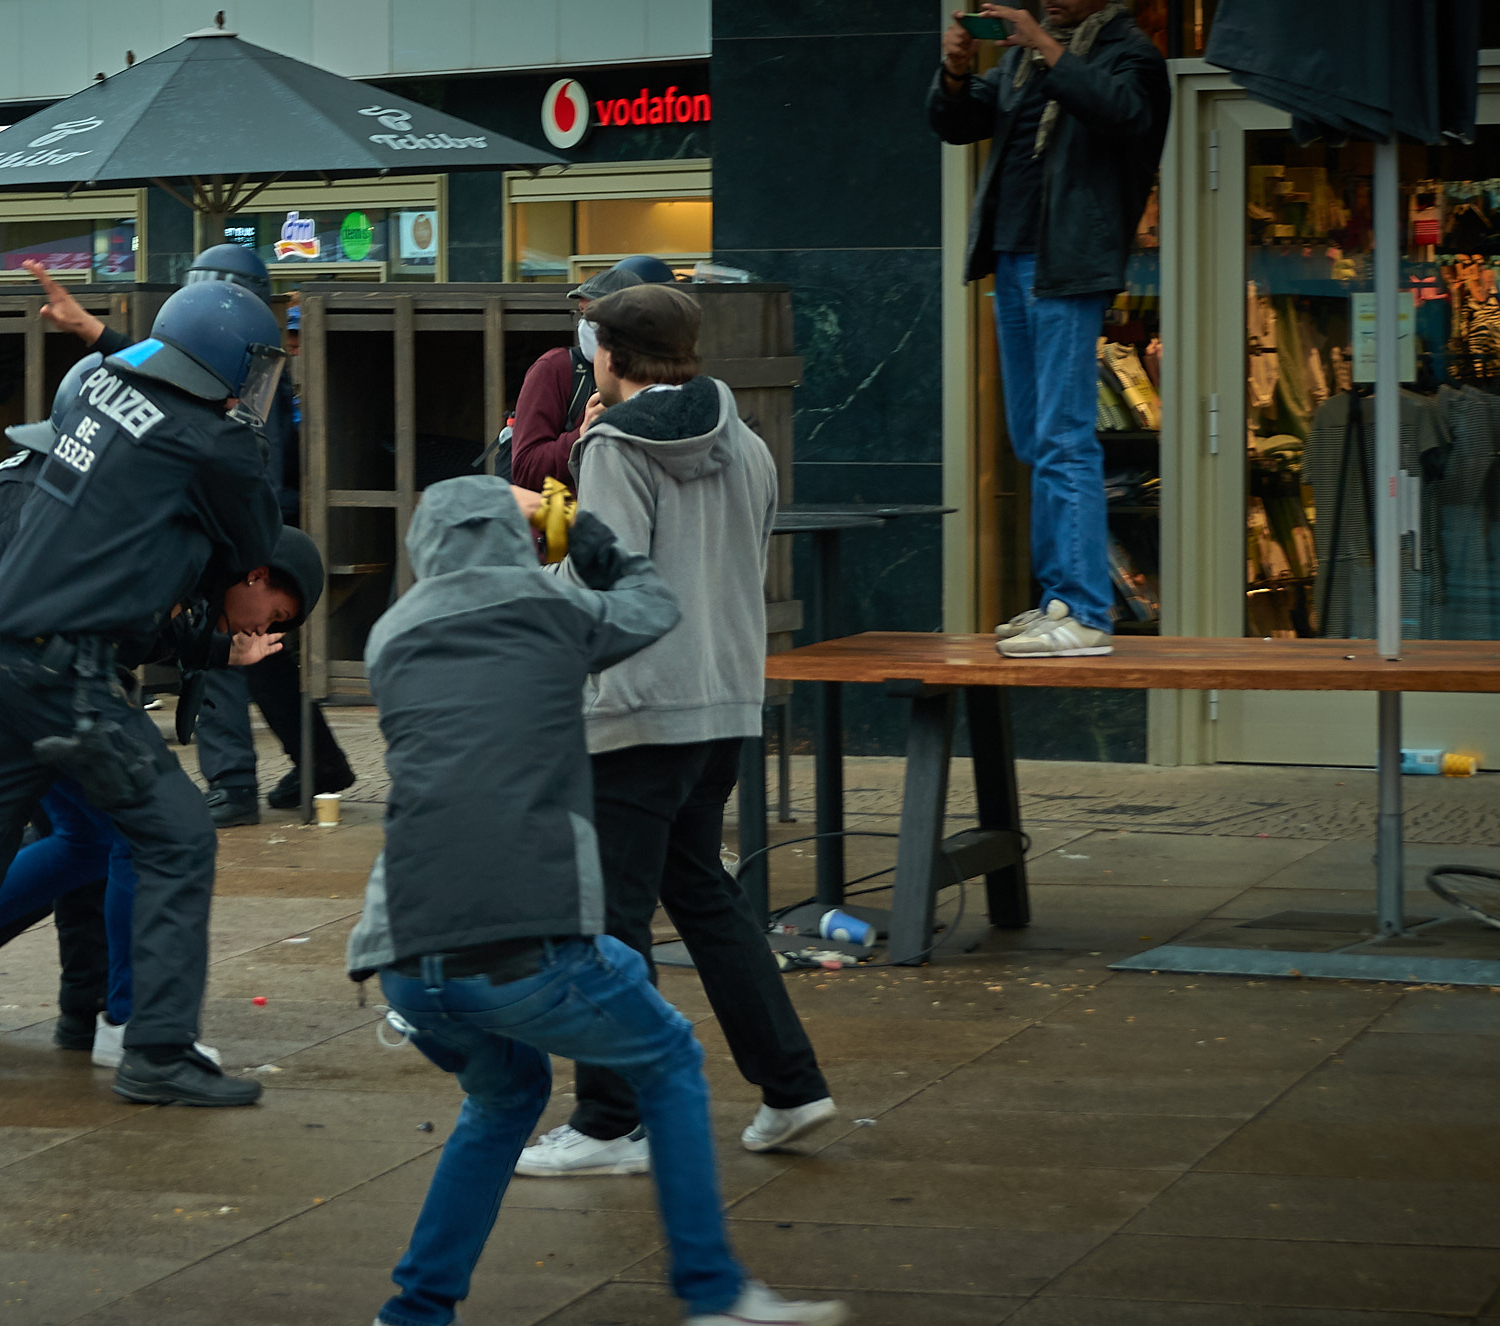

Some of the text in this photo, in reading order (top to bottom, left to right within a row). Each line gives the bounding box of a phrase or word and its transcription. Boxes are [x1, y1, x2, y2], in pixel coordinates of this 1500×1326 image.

[595, 84, 712, 127] vodafon
[368, 133, 489, 150] Tchibo
[78, 366, 166, 439] POLIZEI
[75, 415, 101, 445] BE
[54, 434, 96, 472] 15323
